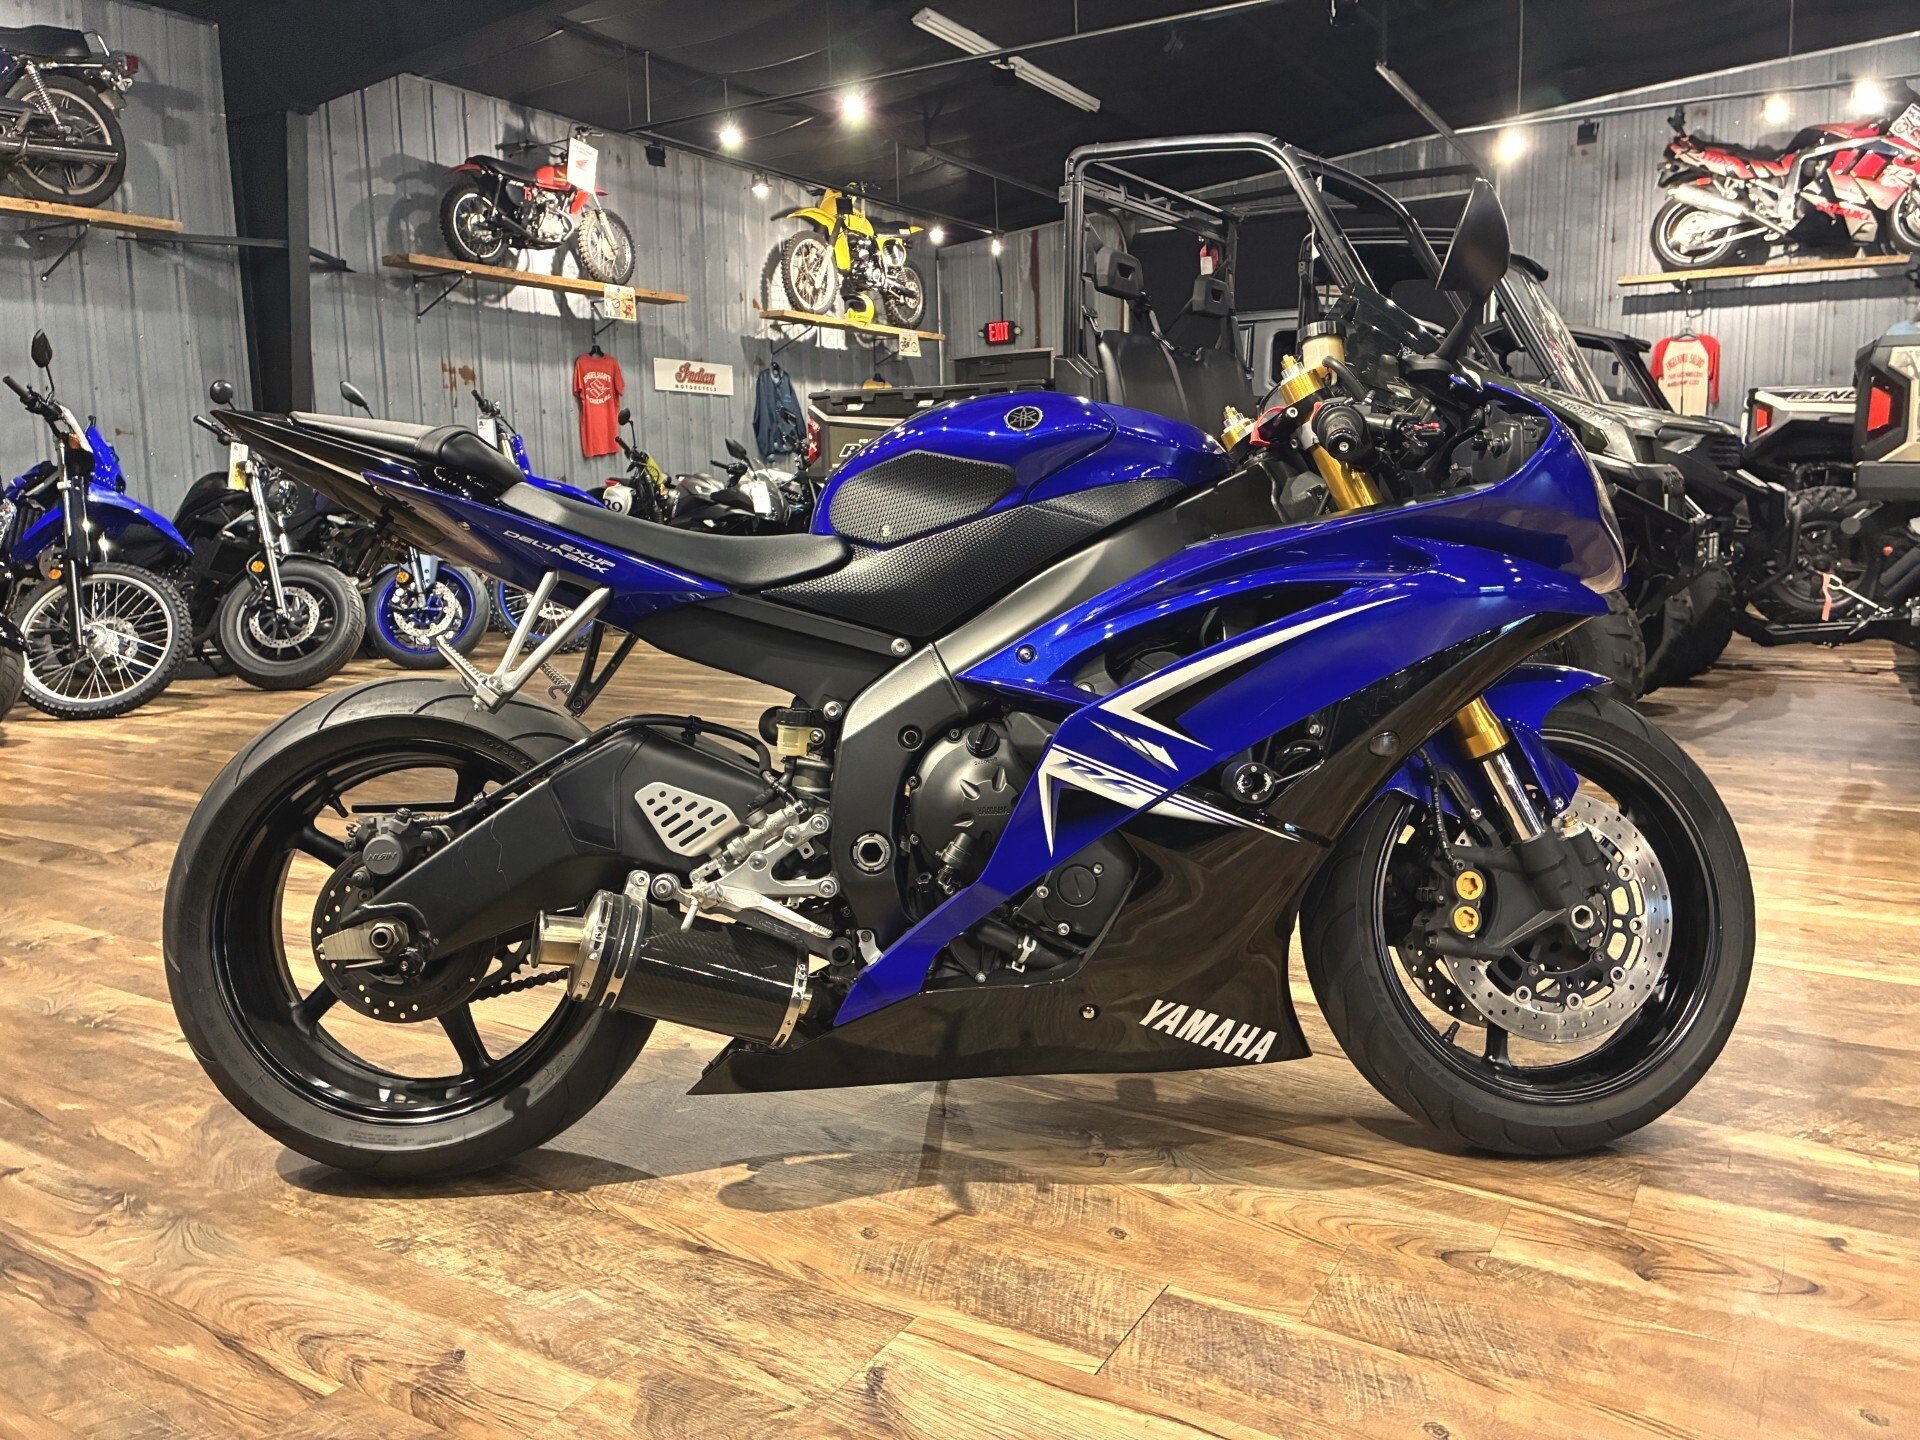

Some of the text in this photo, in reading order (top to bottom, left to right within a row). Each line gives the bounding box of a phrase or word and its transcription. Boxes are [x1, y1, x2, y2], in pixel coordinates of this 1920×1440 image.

[988, 322, 1009, 342] EXIT
[675, 362, 716, 386] Indian
[675, 384, 717, 392] MOTORCYCLE
[502, 530, 609, 574] DELTABOX
[559, 543, 616, 568] EXUP
[1139, 999, 1278, 1064] YAMAHA
